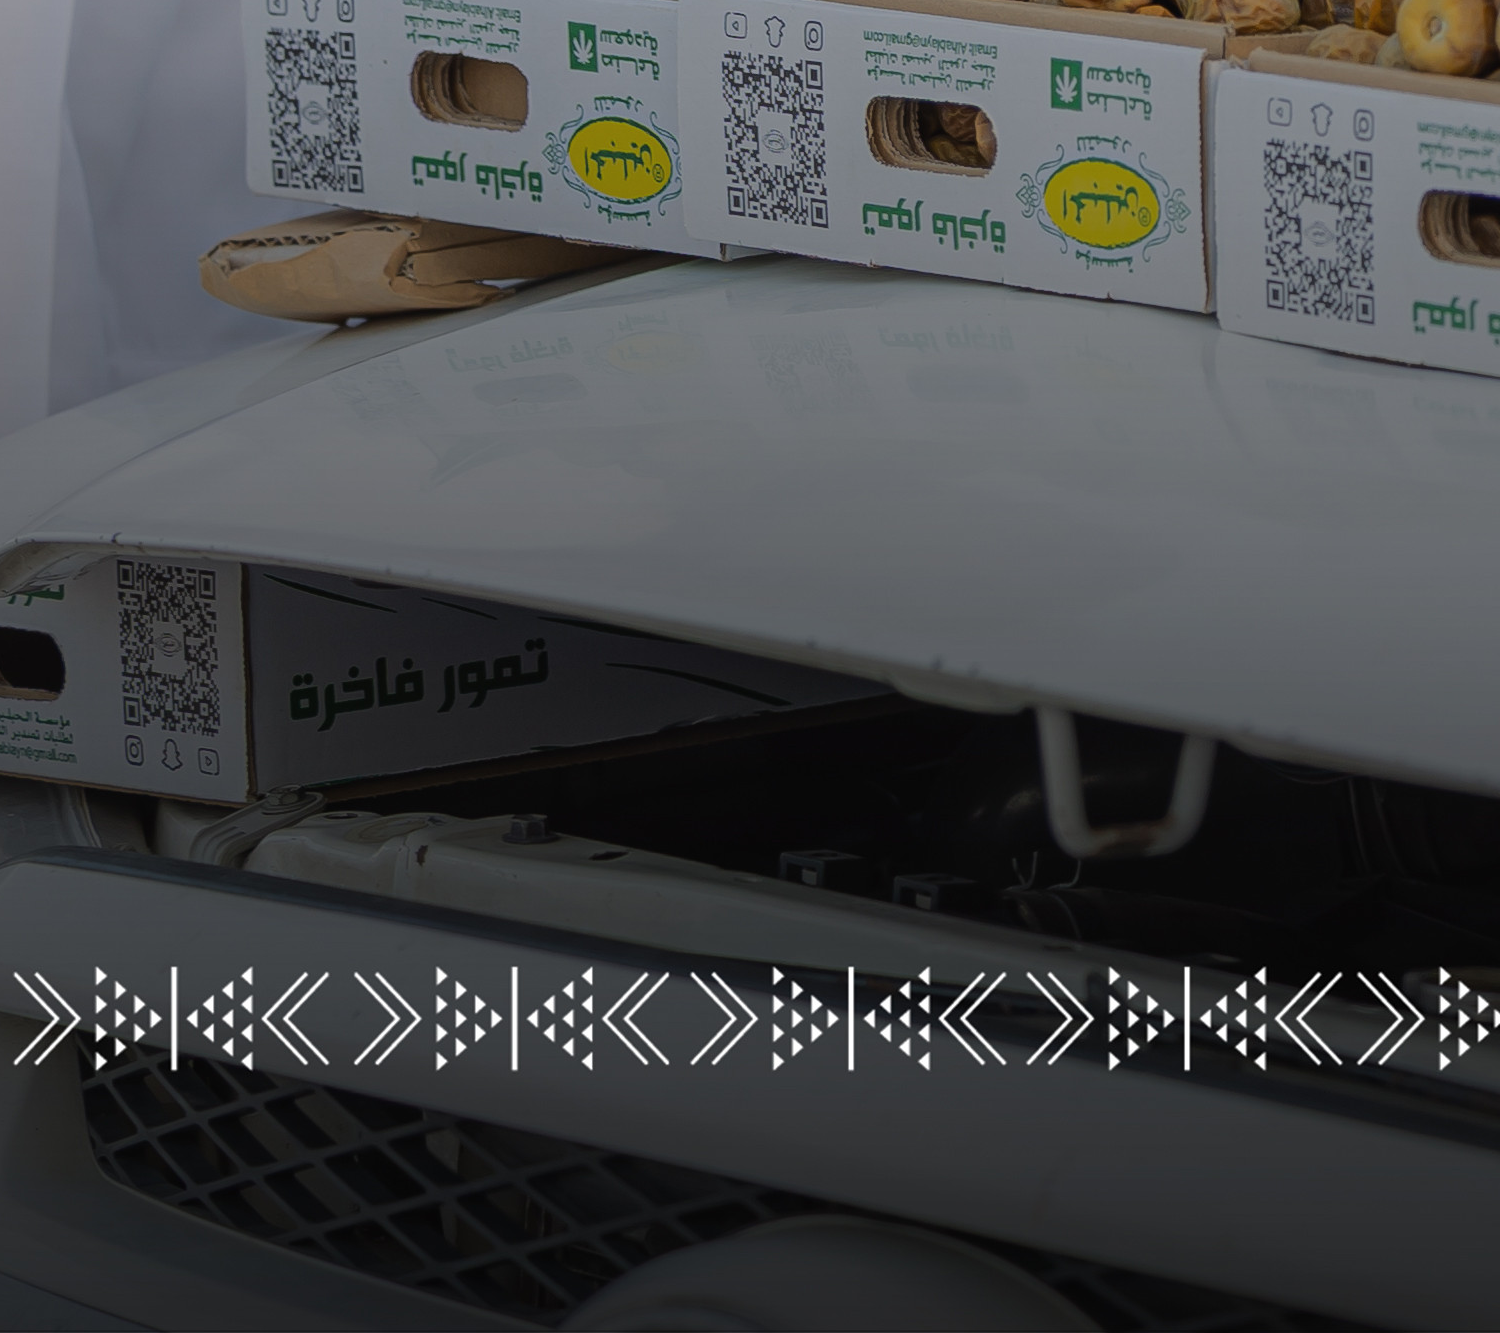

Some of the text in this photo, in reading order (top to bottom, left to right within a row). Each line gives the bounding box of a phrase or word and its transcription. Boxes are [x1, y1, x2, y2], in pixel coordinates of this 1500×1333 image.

[600, 29, 658, 56] سعودية
[601, 54, 660, 81] صناعة
[1087, 66, 1151, 95] سعودية
[594, 96, 644, 112] للتمور
[1087, 91, 1152, 121] صناعة
[1076, 135, 1132, 153] للتمور
[412, 151, 543, 203] تمور فاخرة
[598, 204, 651, 226] مؤسسة
[862, 198, 1006, 254] تمور فاخرة
[1075, 250, 1134, 273] مؤسسة
[1412, 297, 1479, 335] تمور
[290, 637, 549, 732] تمور فاخرة
